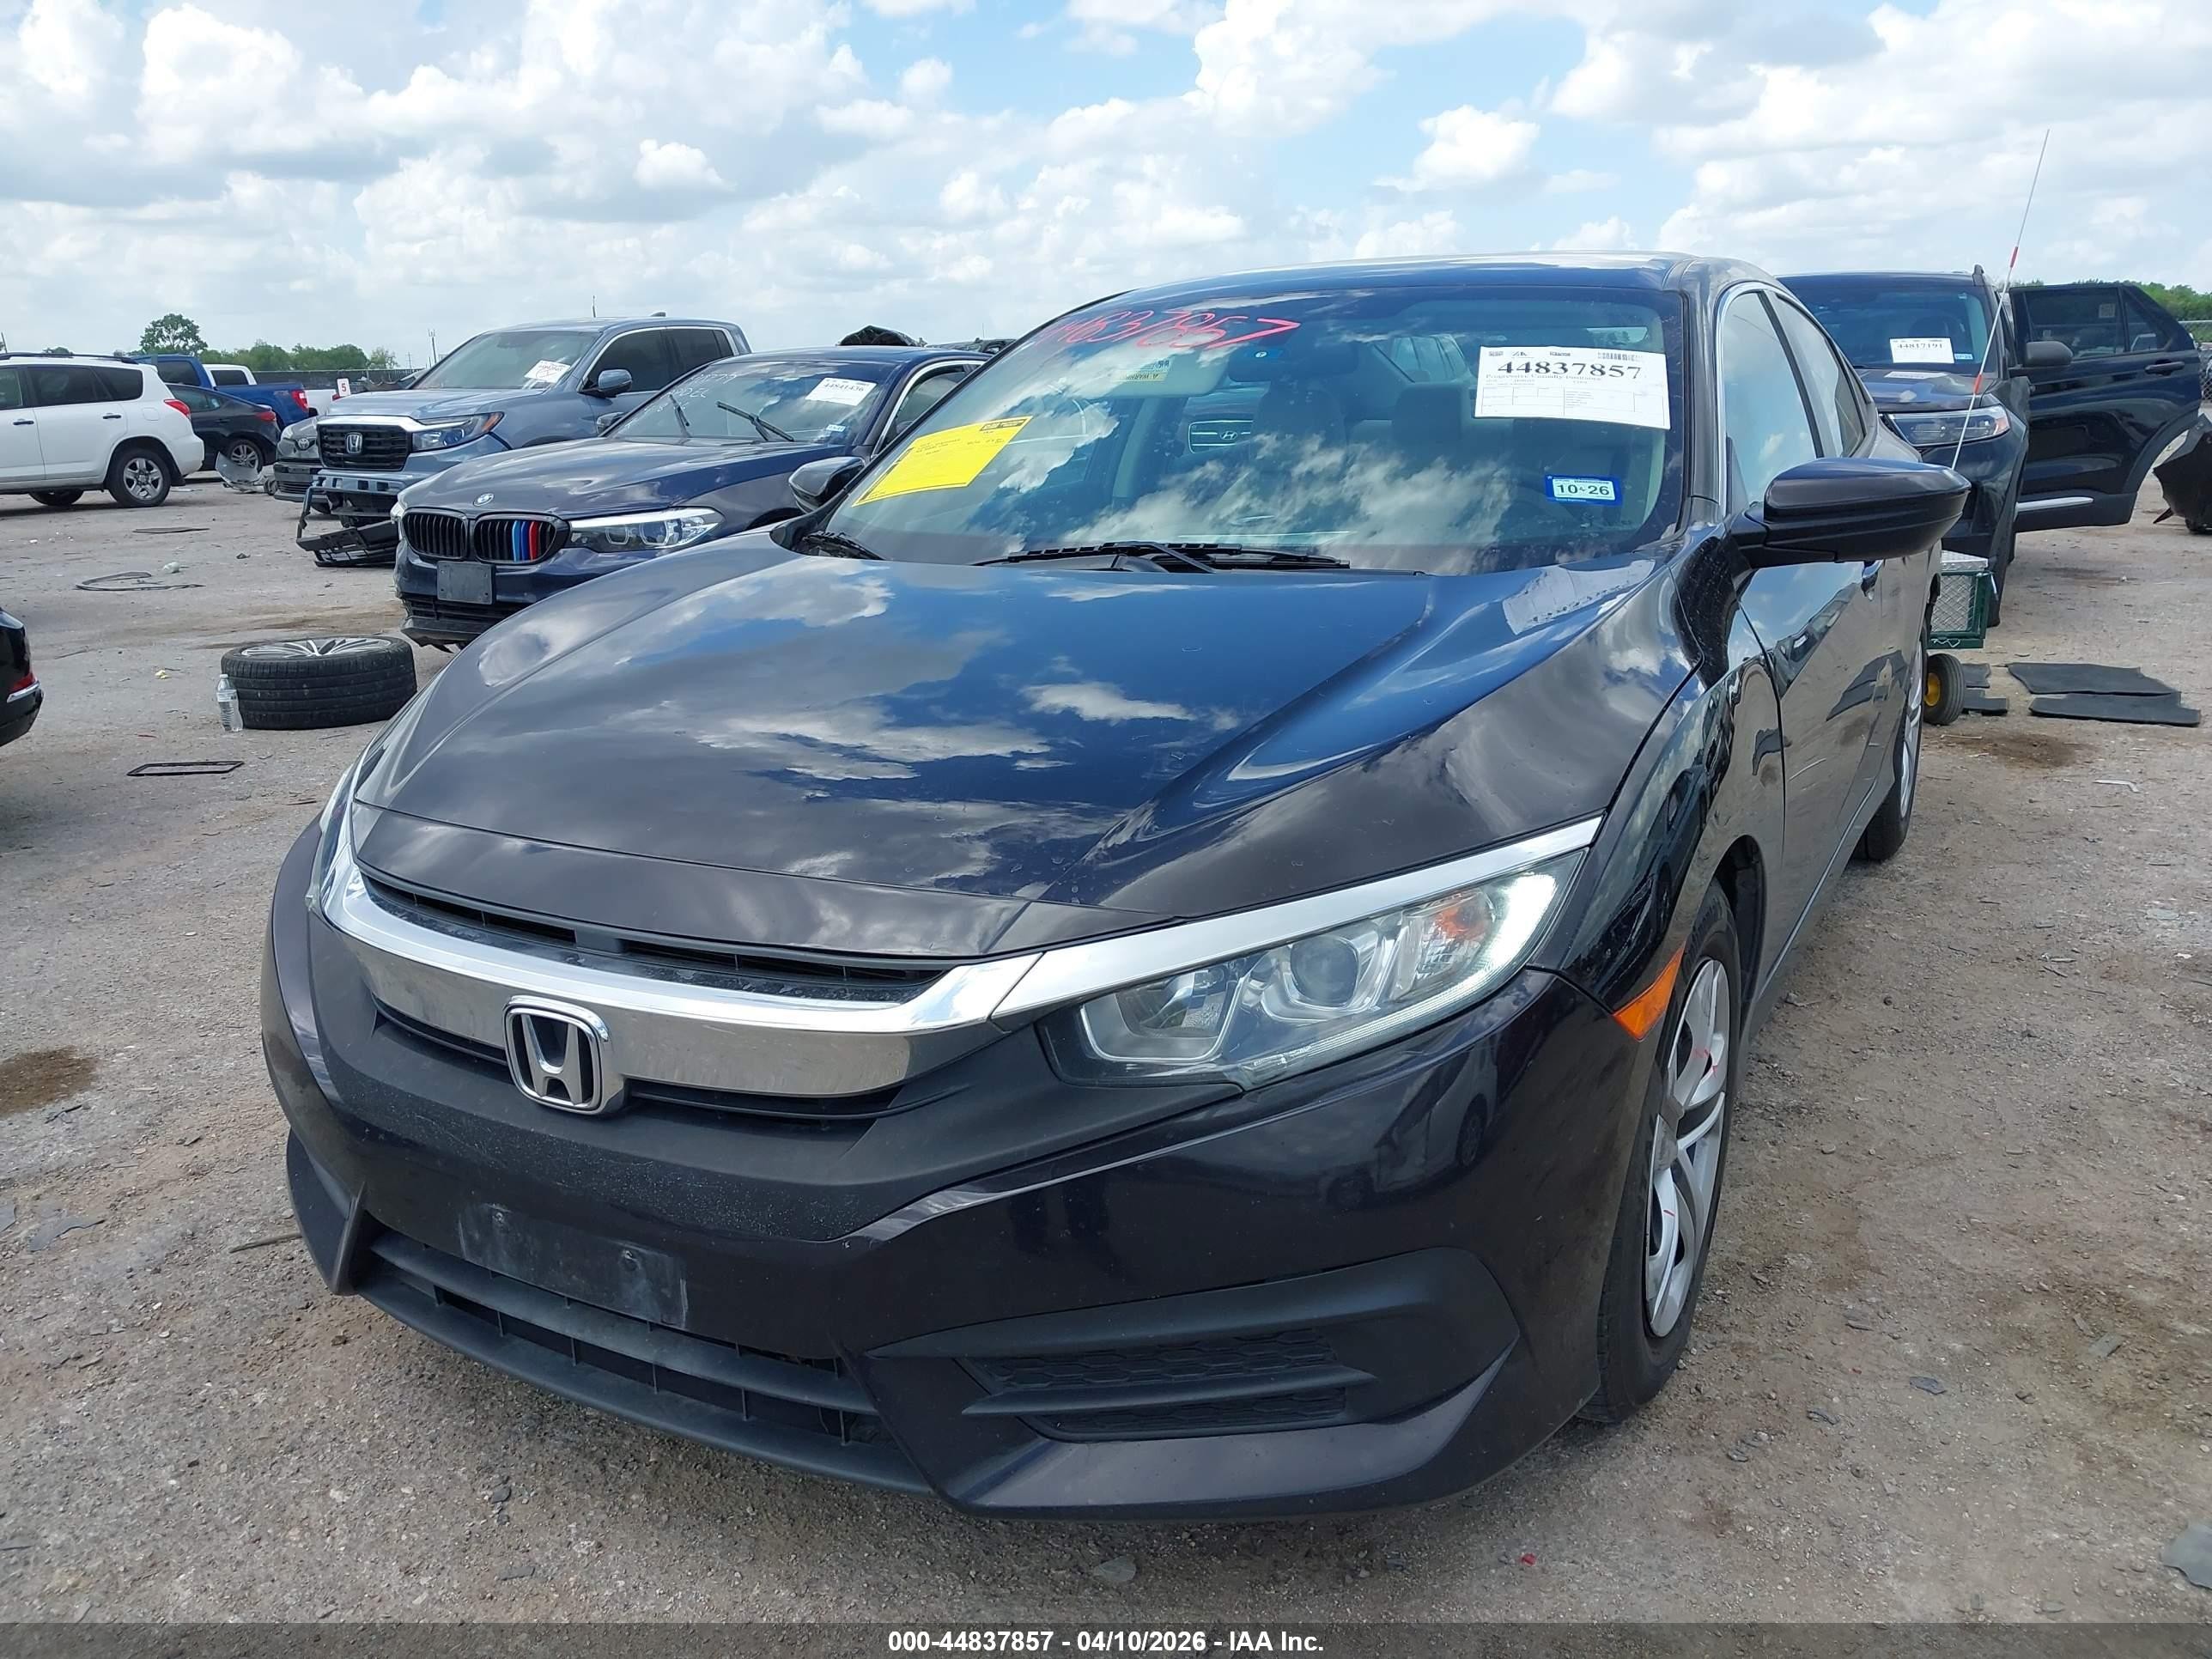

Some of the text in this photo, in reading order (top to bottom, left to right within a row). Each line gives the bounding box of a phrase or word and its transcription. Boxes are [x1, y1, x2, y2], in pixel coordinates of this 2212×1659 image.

[1497, 361, 1641, 380] 44837857
[341, 383, 347, 392] 5
[1556, 483, 1610, 495] 10-26
